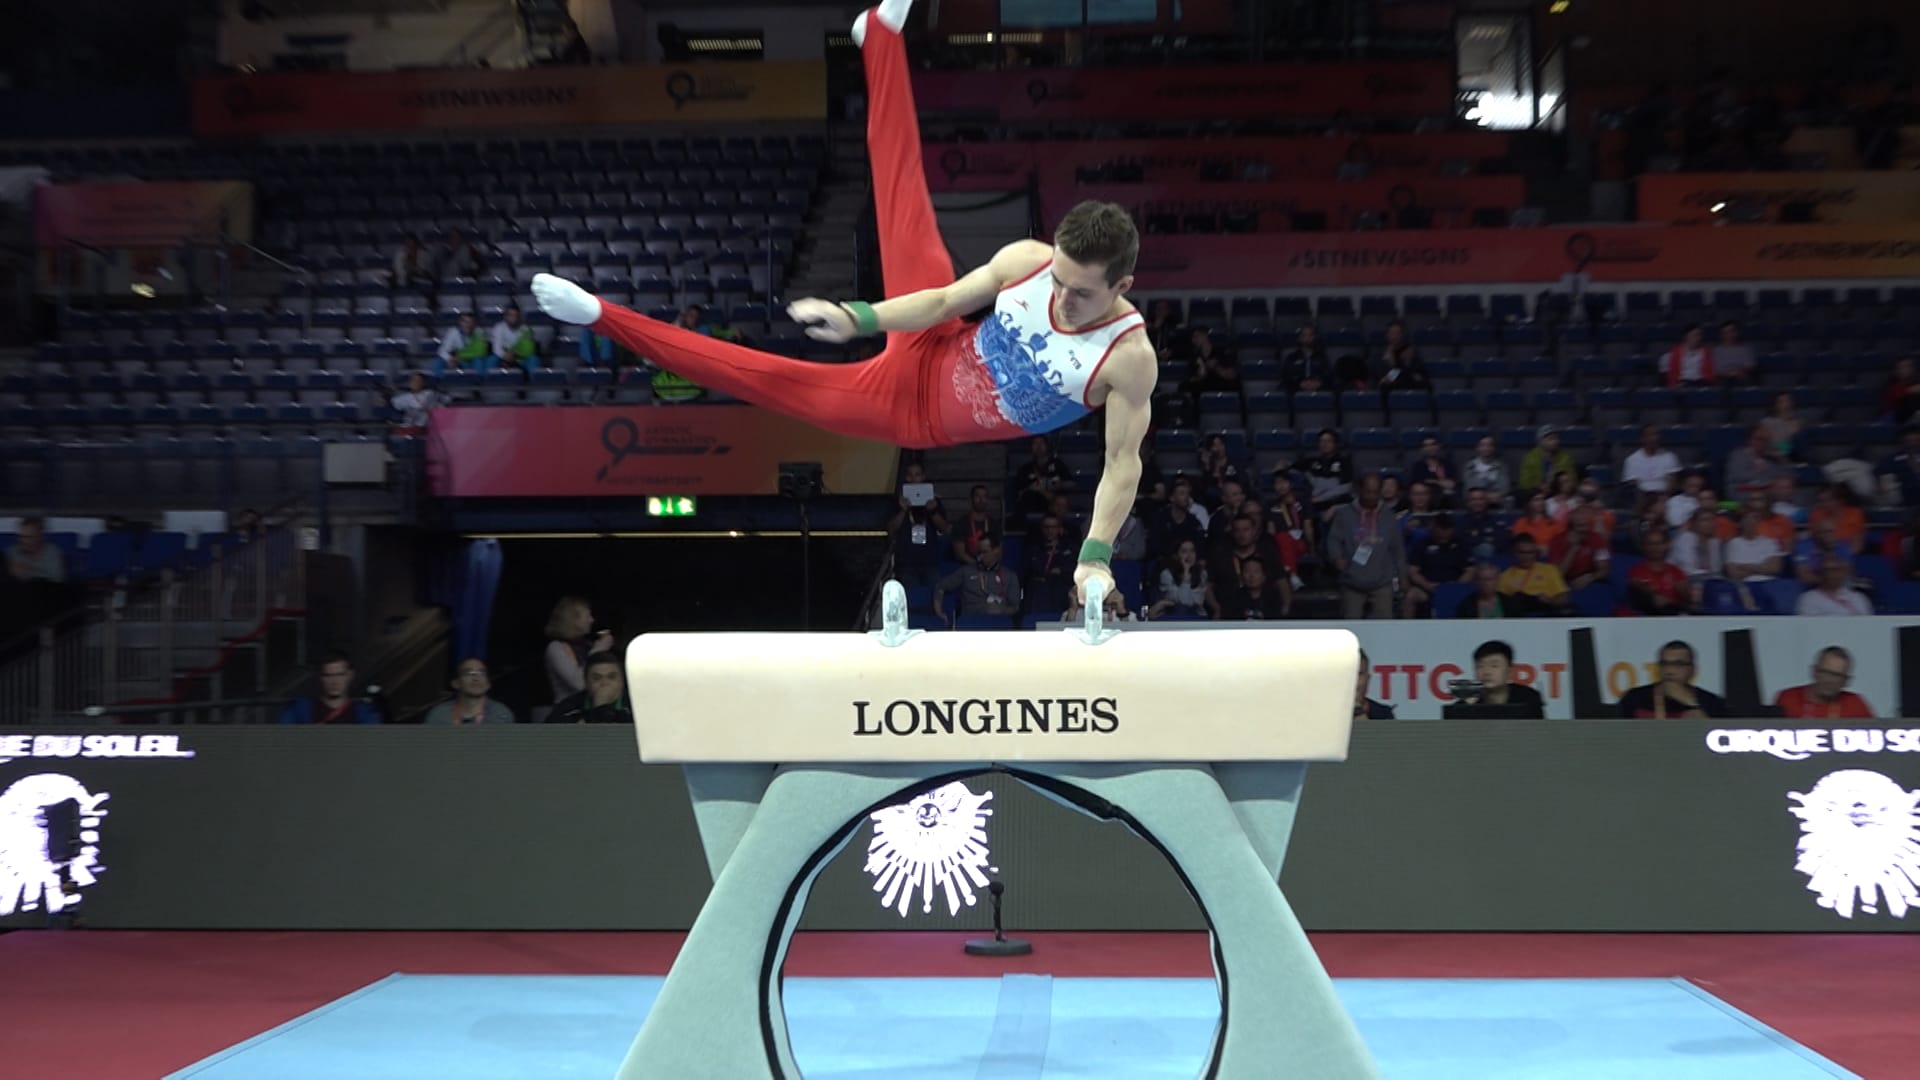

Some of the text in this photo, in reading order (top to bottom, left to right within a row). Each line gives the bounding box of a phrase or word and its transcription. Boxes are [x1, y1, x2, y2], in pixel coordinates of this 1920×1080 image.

[1288, 247, 1472, 269] #SETNEWSIGNS
[852, 697, 1119, 736] LONGINES
[32, 735, 82, 757] DU
[1831, 728, 1885, 752] DU
